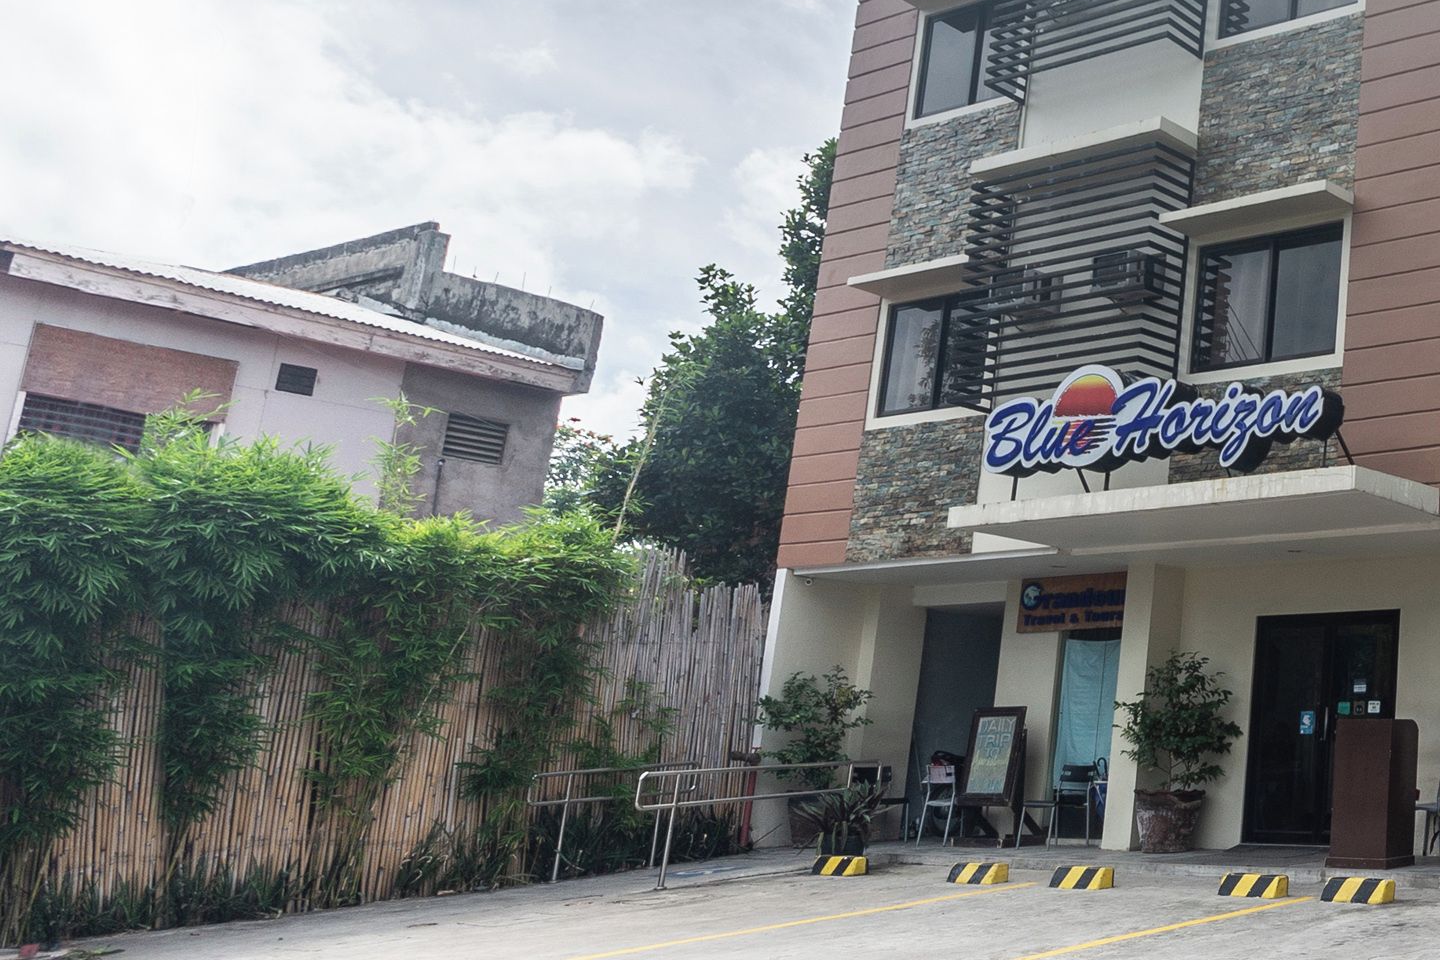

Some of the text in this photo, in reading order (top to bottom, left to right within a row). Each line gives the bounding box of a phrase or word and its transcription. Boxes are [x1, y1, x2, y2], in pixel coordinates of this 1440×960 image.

[986, 380, 1319, 467] Blue Horizon
[1023, 613, 1066, 626] Travel
[1069, 613, 1079, 624] &
[979, 718, 1016, 733] DAILY
[978, 733, 1011, 749] TRIP
